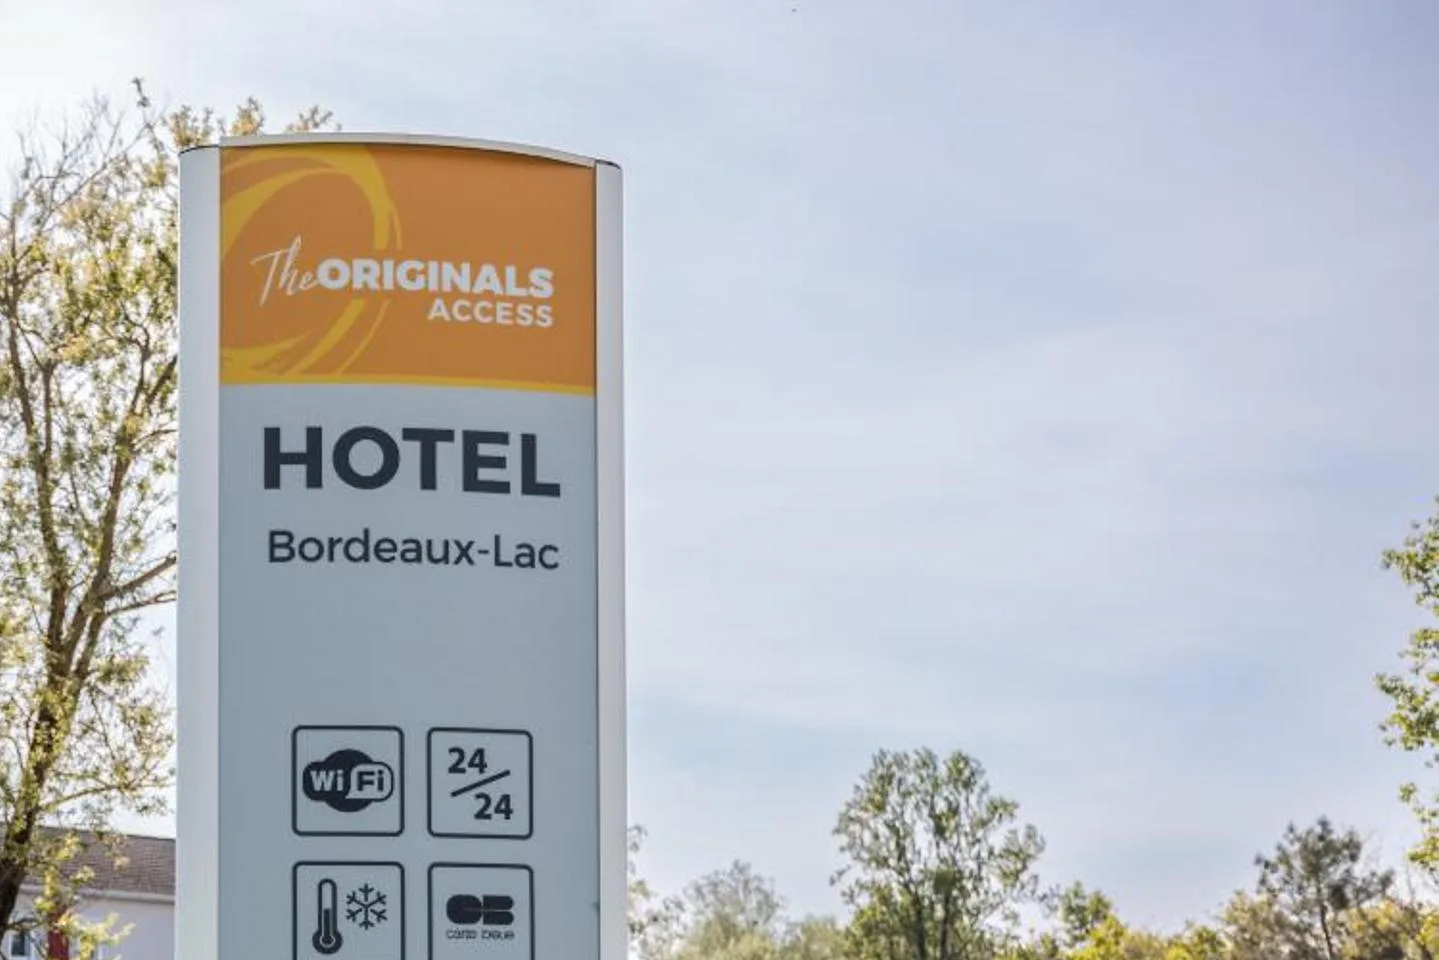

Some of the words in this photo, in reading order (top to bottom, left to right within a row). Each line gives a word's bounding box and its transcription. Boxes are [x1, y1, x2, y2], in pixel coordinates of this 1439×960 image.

[250, 234, 318, 306] The
[316, 258, 554, 299] ORIGINALS
[427, 298, 554, 328] ACCESS
[263, 425, 561, 498] HOTEL
[267, 528, 560, 571] Bordeaux-Lac
